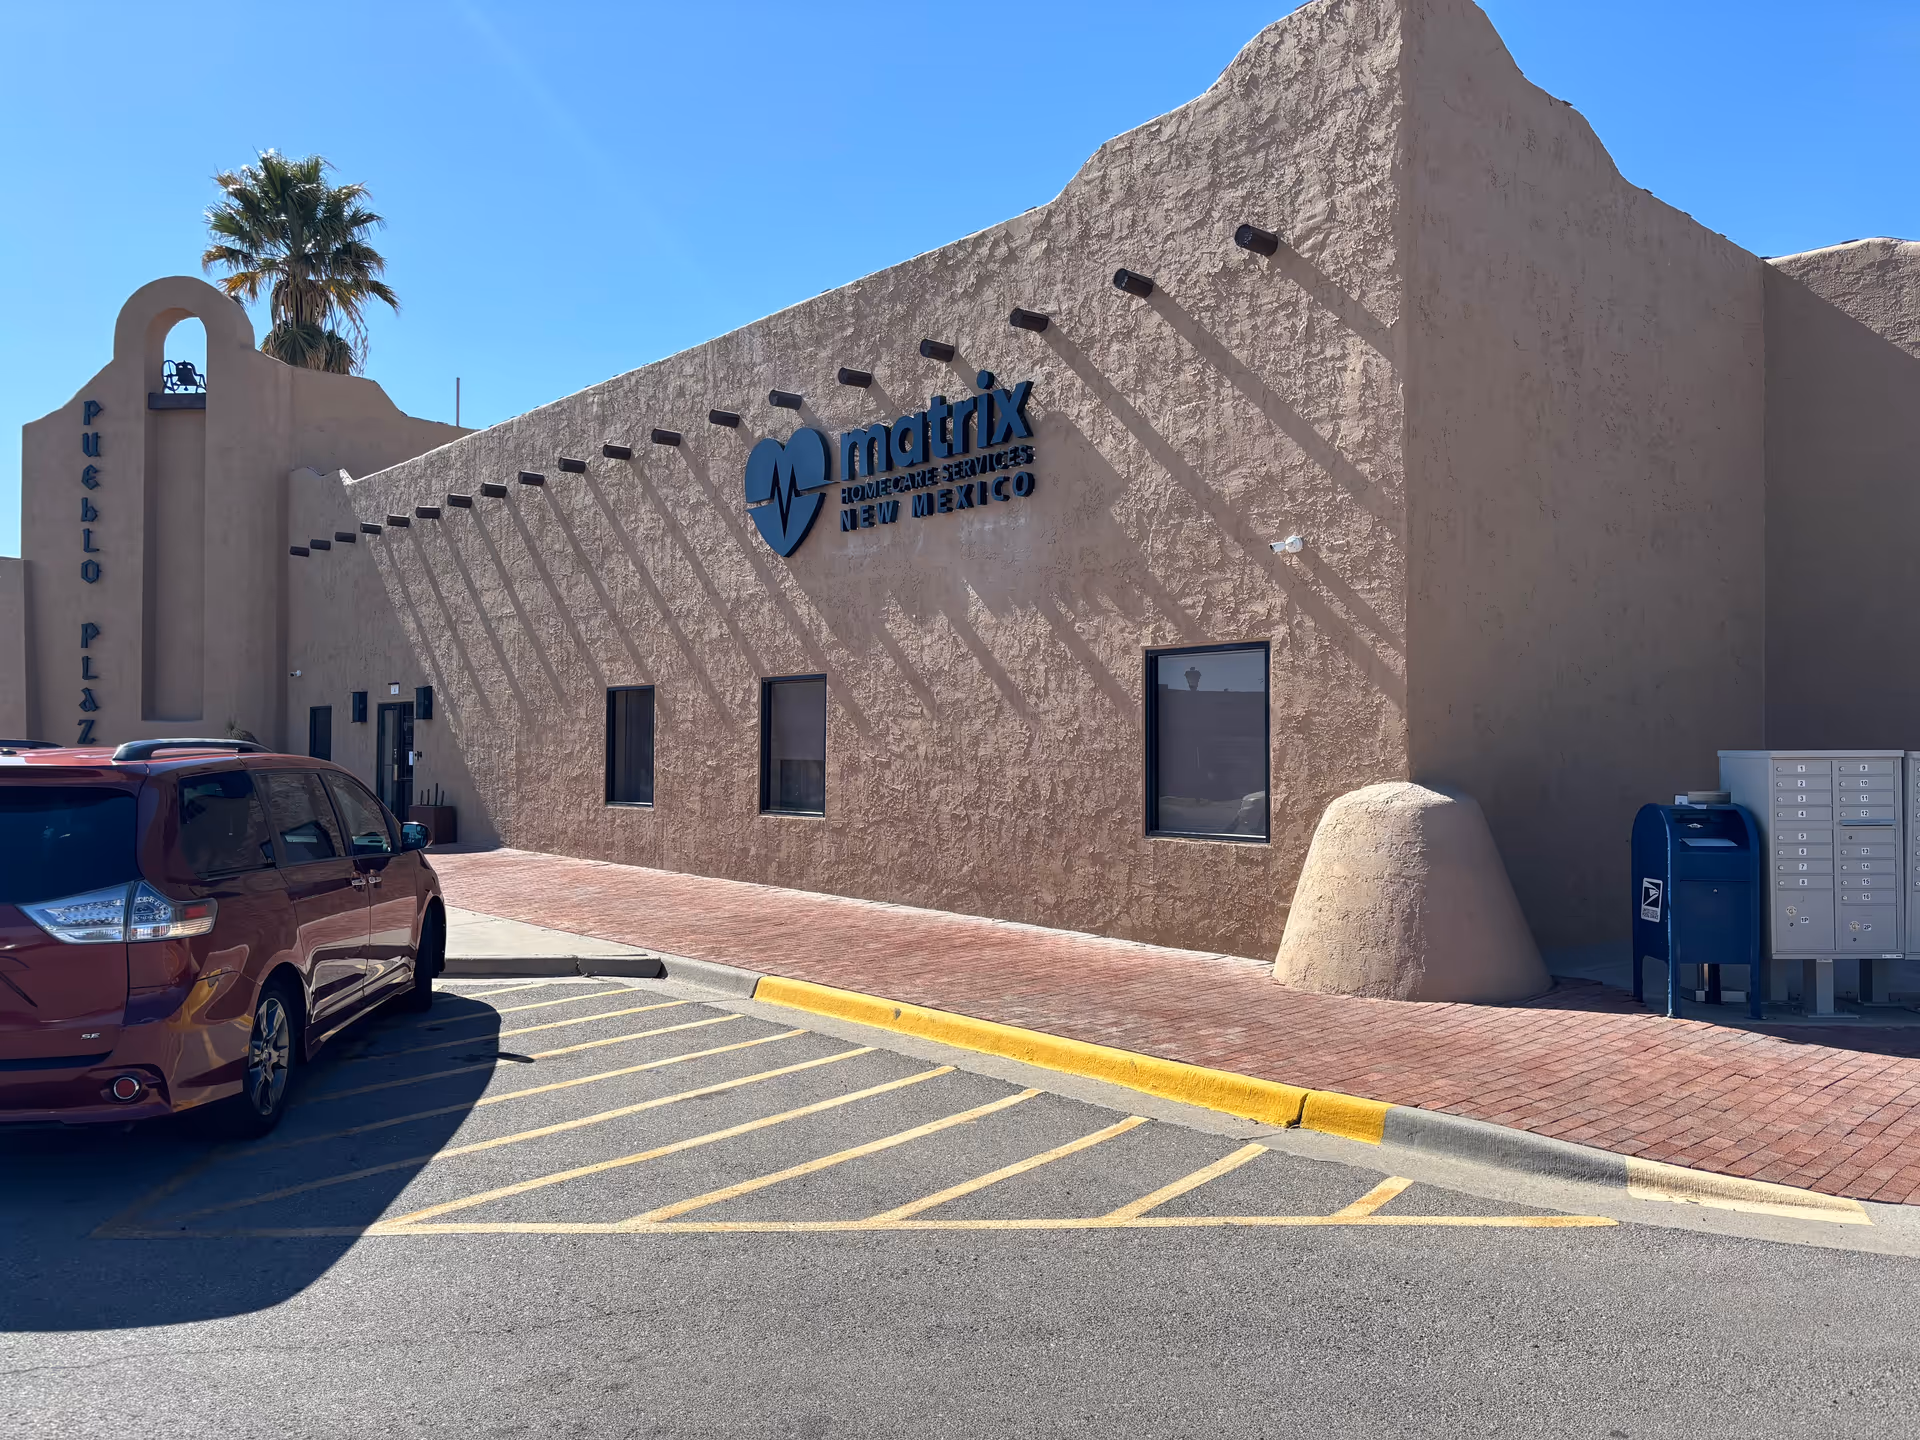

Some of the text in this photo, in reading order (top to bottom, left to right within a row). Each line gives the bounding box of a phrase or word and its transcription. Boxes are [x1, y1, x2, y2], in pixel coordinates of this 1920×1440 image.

[840, 369, 1034, 481] matrix
[942, 445, 1035, 482] SERVICES
[840, 471, 1035, 532] NEW MEXICO
[77, 622, 100, 745] PLAZ
[80, 1032, 100, 1040] SE
